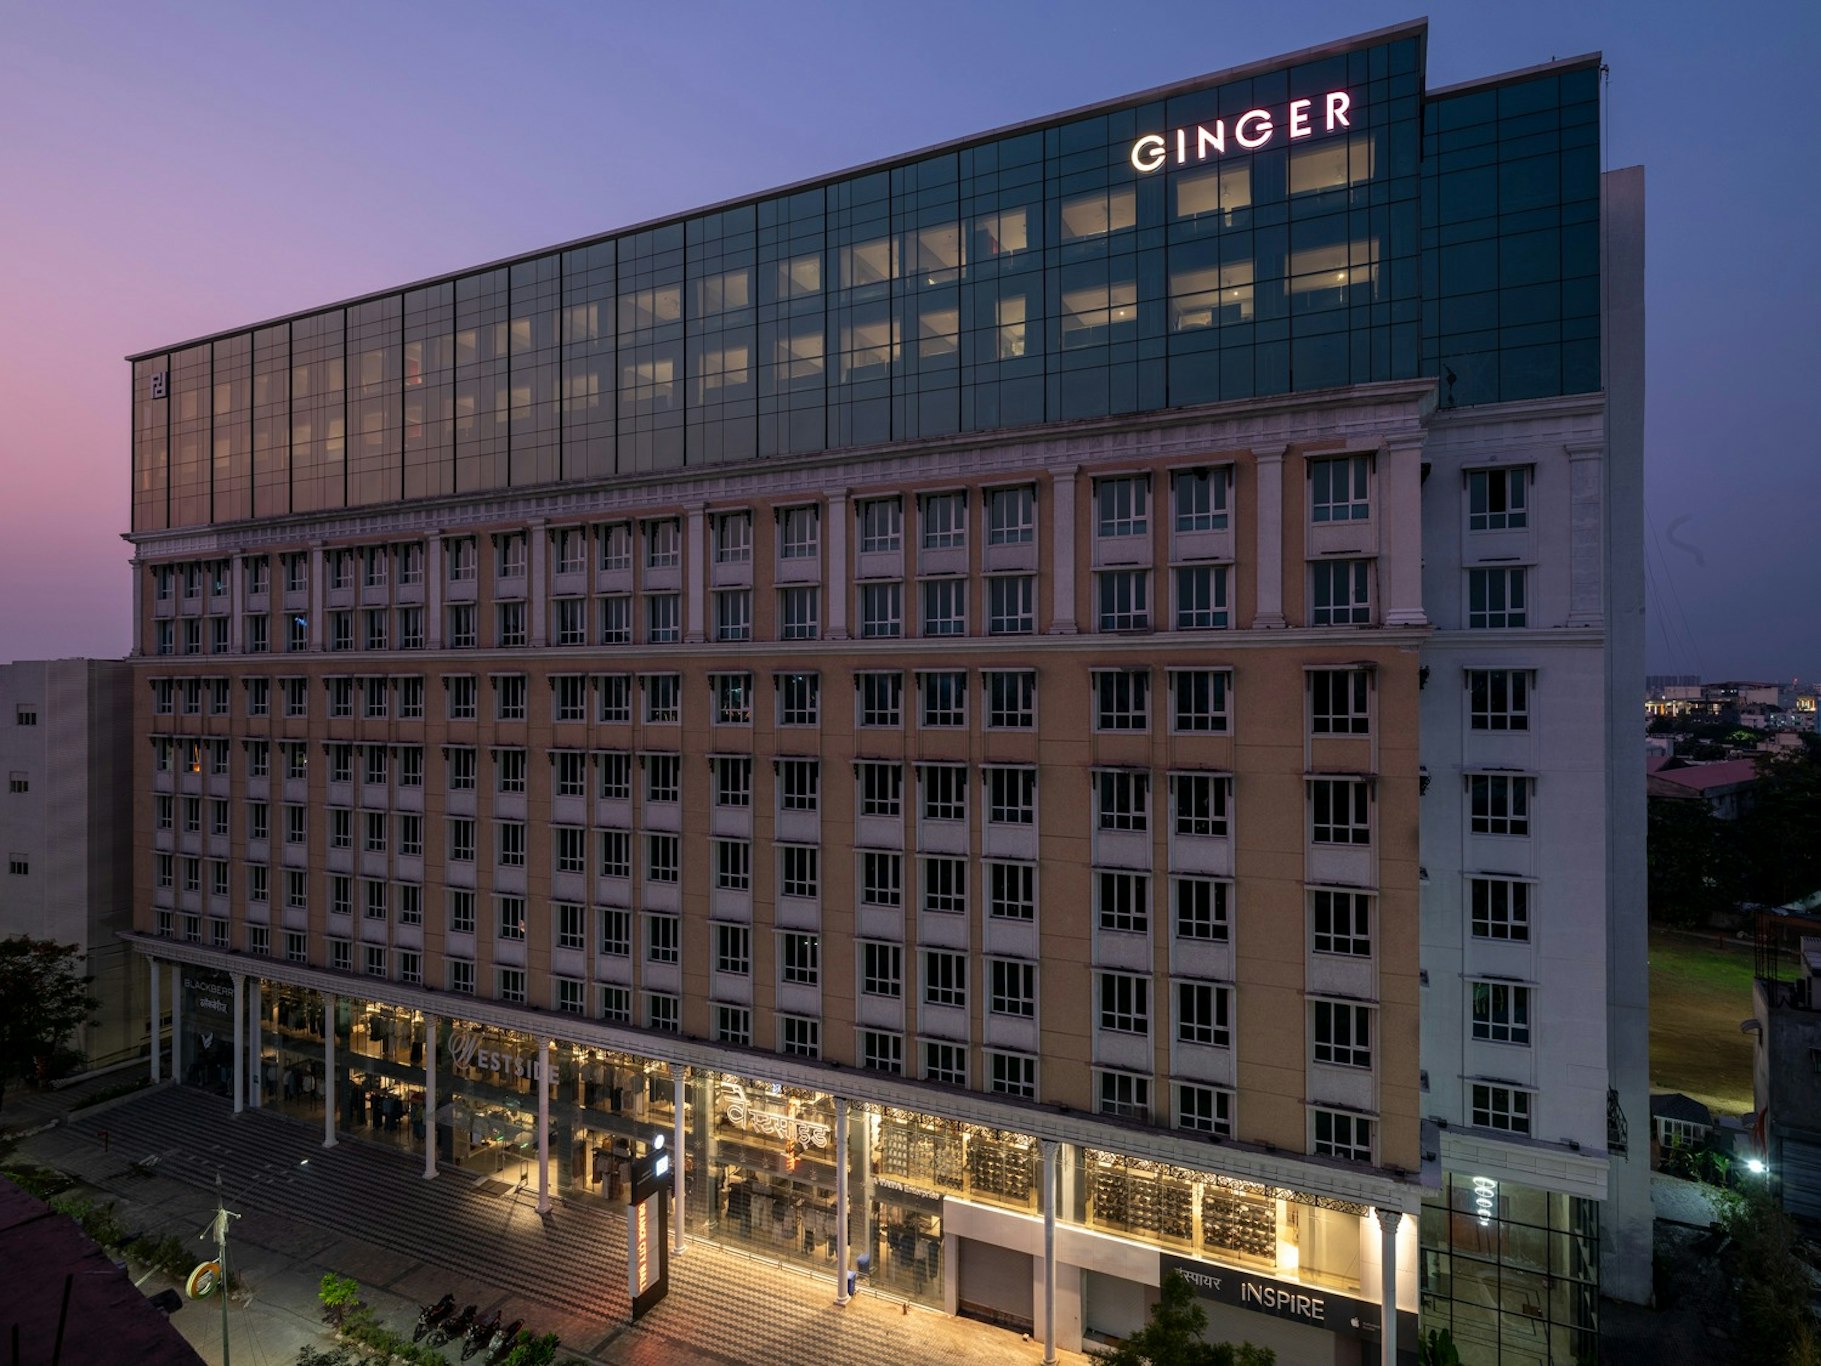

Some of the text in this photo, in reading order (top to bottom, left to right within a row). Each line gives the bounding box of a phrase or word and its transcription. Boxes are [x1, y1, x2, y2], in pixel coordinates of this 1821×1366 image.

[1131, 91, 1350, 172] GINGER
[184, 979, 235, 997] BLACKBERR
[637, 1203, 648, 1292] ORANGE CITY MALL
